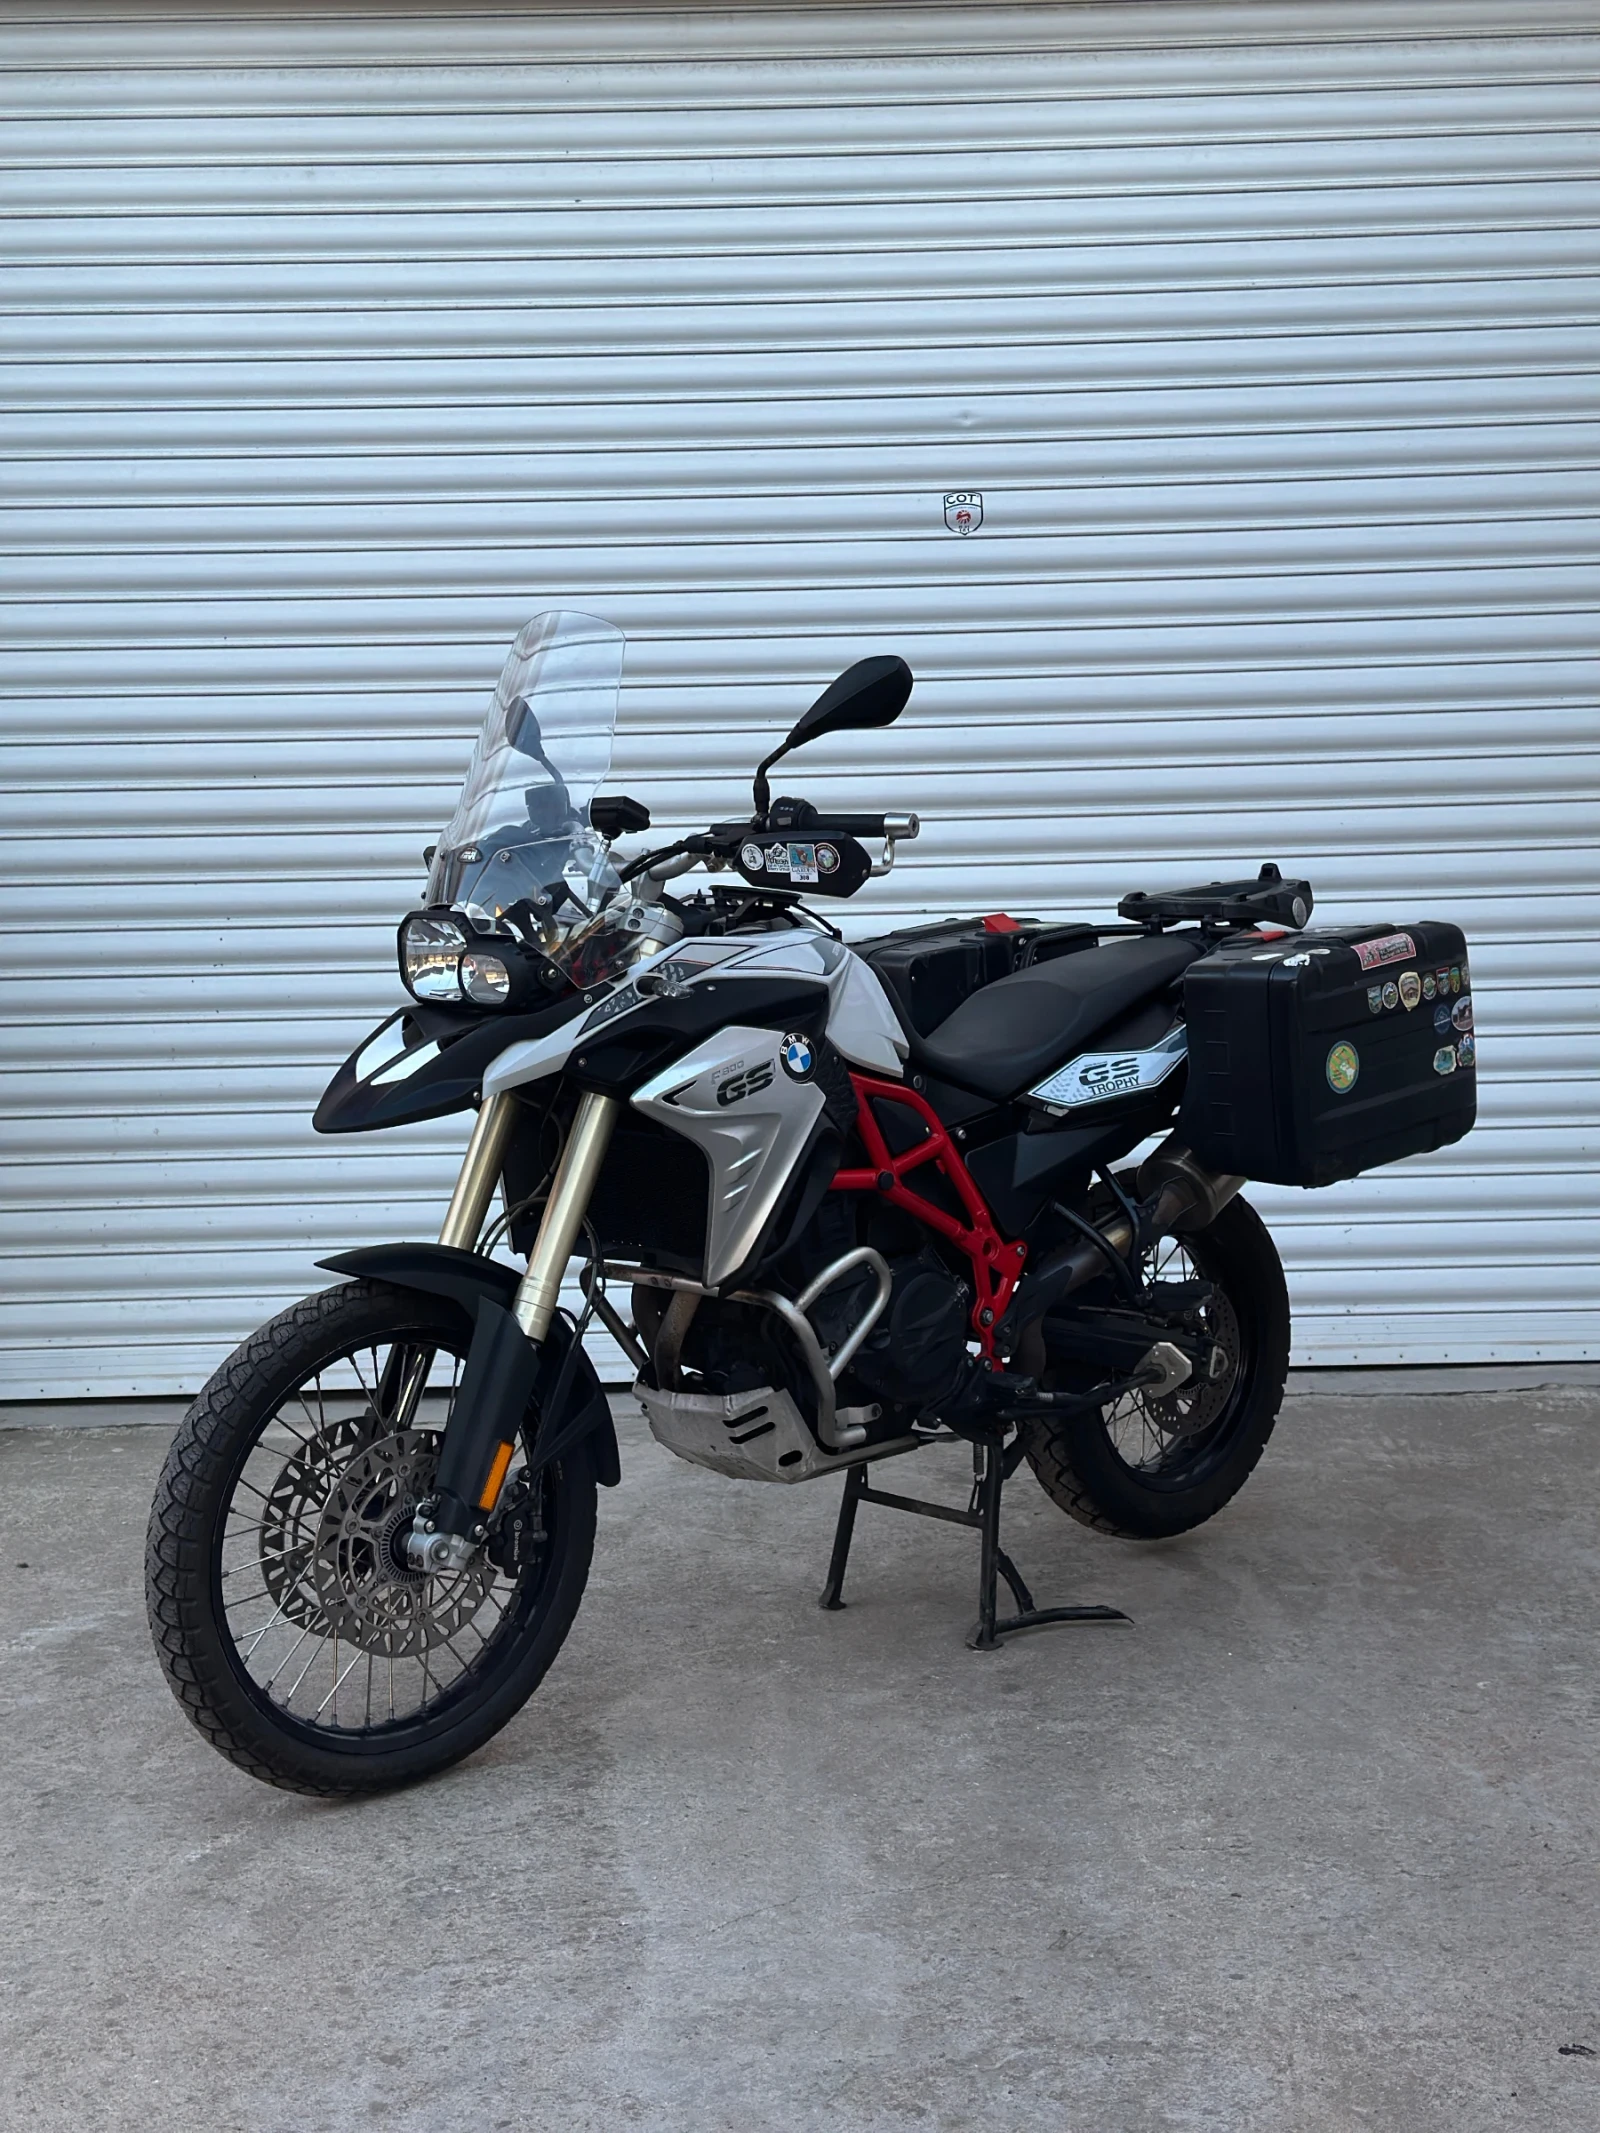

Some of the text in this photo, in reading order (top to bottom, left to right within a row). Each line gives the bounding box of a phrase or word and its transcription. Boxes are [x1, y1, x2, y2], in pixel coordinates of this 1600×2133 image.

[946, 494, 977, 504] COT
[780, 1035, 810, 1056] BMW
[716, 1058, 776, 1107] GS
[1079, 1057, 1140, 1086] GS
[1088, 1075, 1140, 1096] TROPHY
[513, 1531, 521, 1561] brembo
